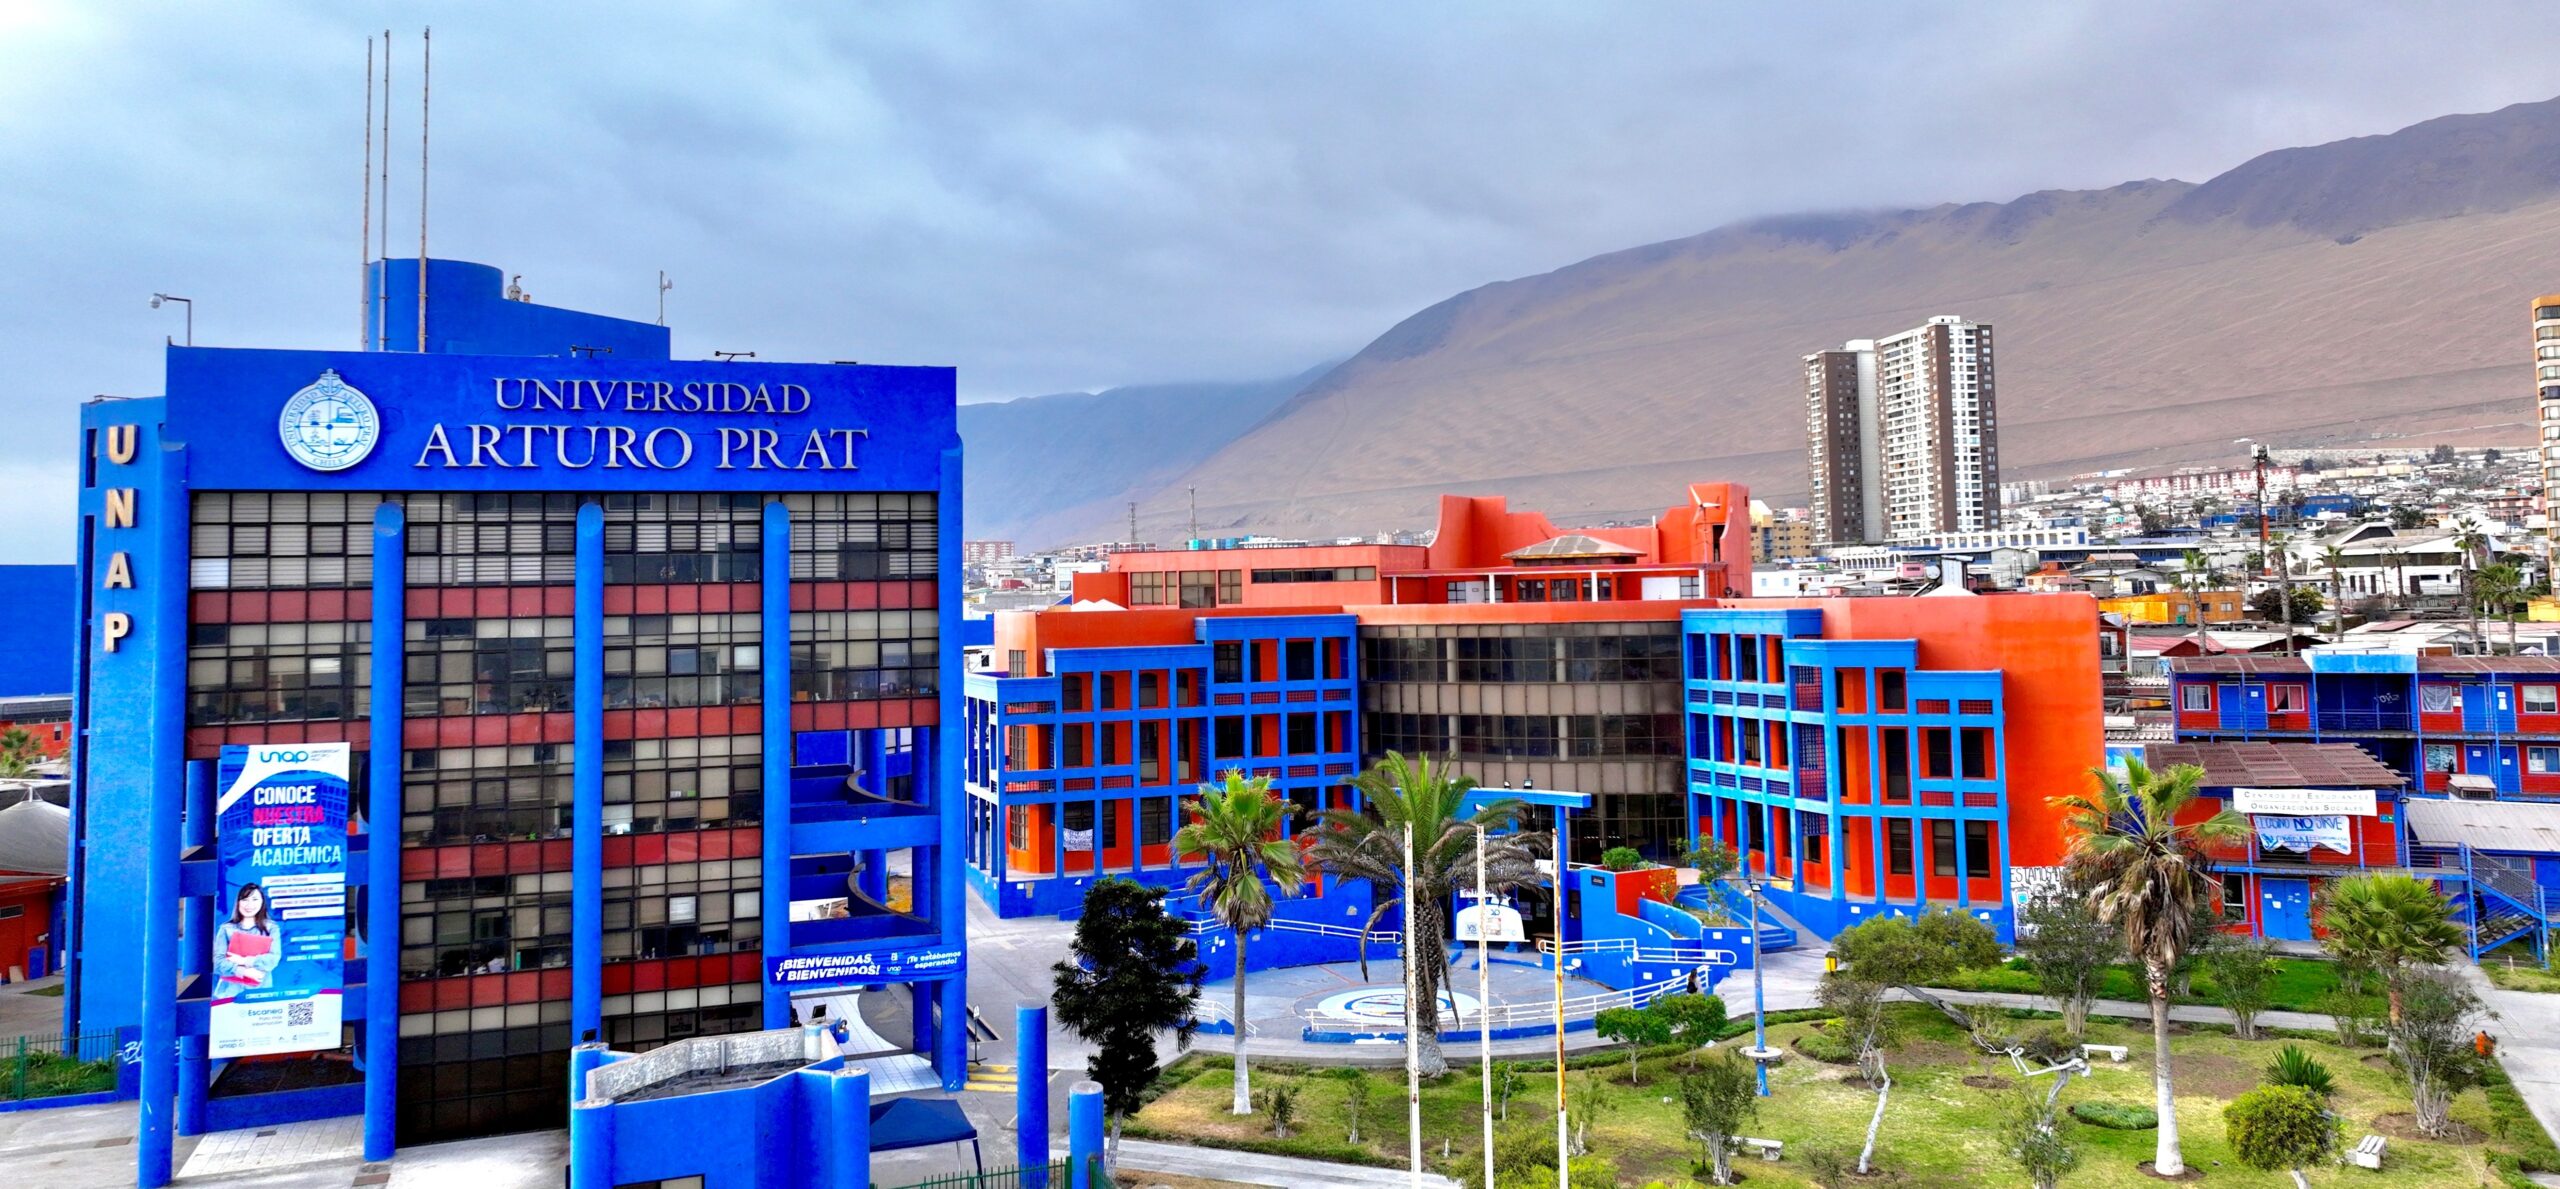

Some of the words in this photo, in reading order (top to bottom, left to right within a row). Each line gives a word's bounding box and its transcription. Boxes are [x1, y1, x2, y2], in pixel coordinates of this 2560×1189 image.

[493, 377, 812, 414] UNIVERSIDAD
[286, 390, 319, 447] UNIVERSIDAD
[413, 421, 694, 470] ARTURO
[715, 426, 869, 470] PRAT
[312, 458, 346, 466] CHILE
[103, 424, 140, 653] UNAP
[253, 785, 317, 806] CONOCE
[252, 805, 325, 826] NUESTRA
[2250, 802, 2320, 811] ORGANIZACIONES
[2323, 804, 2364, 812] SOCIALES
[2293, 818, 2313, 830] NO
[251, 826, 312, 847] OFERTA
[251, 841, 342, 867] ACADÉMICA
[775, 971, 784, 981] Y
[787, 965, 881, 981] BIENVENIDOS!
[914, 957, 958, 969] esperando!
